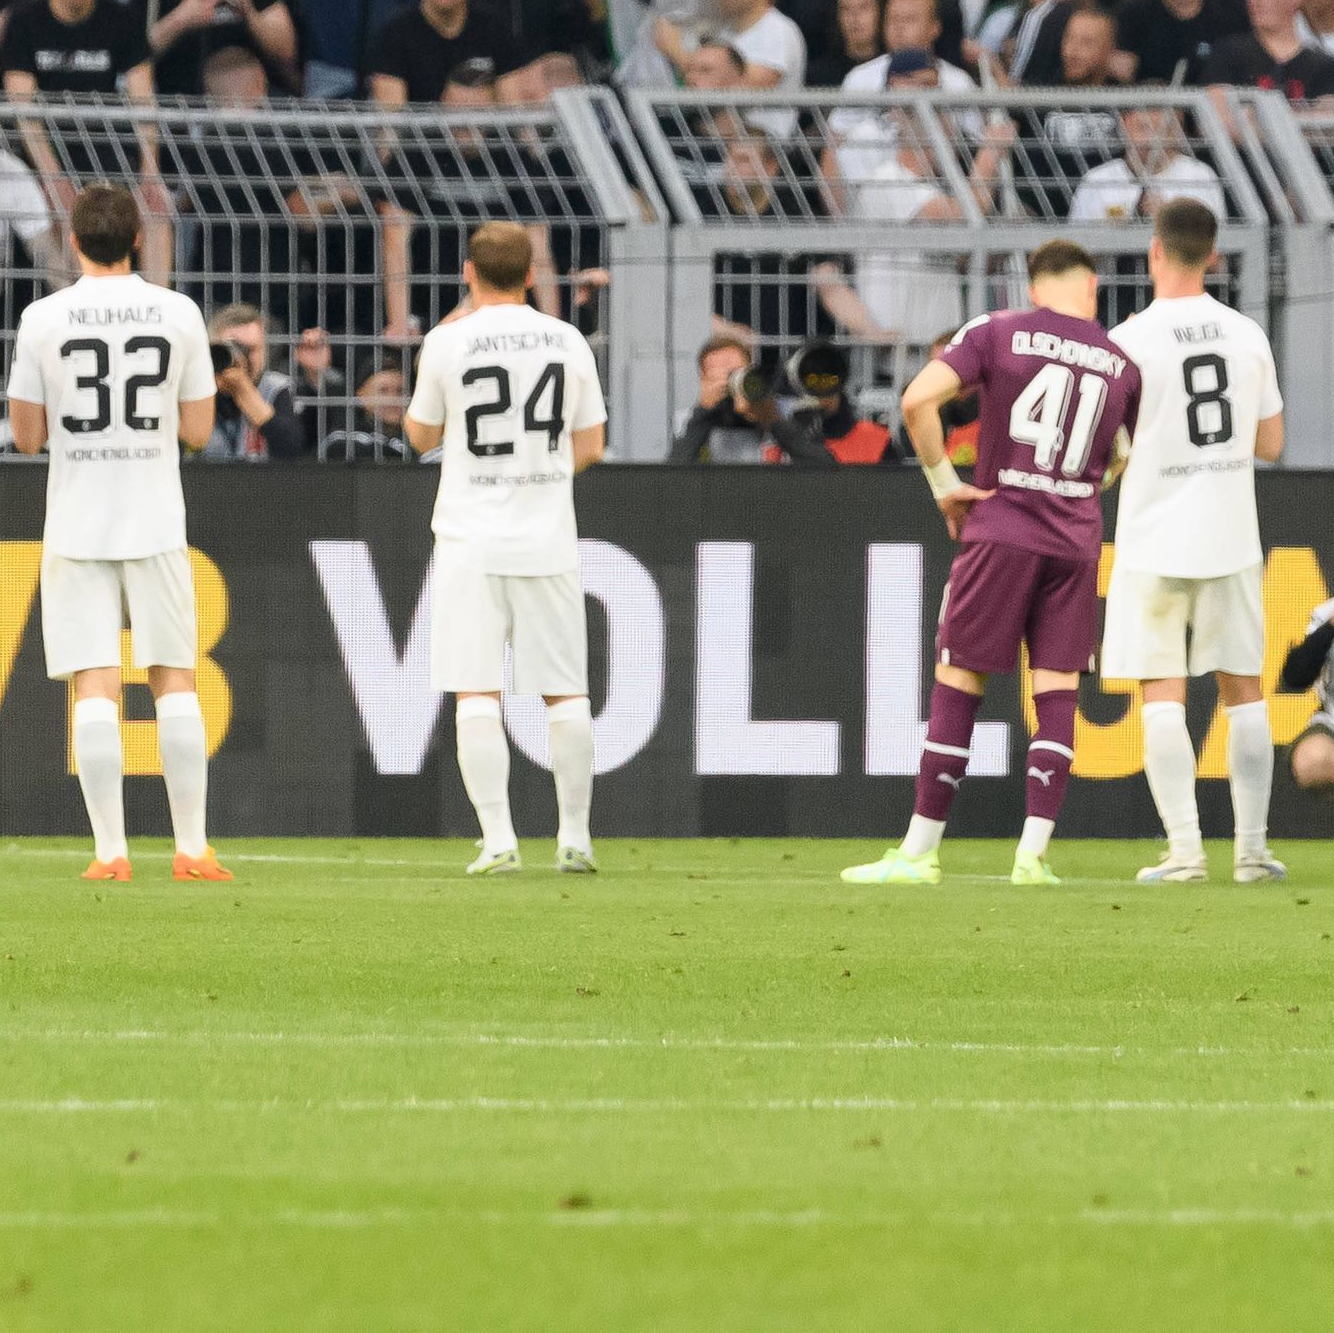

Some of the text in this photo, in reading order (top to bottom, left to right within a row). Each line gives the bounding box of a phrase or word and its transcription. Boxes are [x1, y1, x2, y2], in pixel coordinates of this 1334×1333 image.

[68, 306, 161, 325] NEUHAUS
[60, 335, 171, 433] 32
[462, 362, 565, 456] 24
[1009, 363, 1109, 479] 41
[1182, 353, 1233, 447] 8
